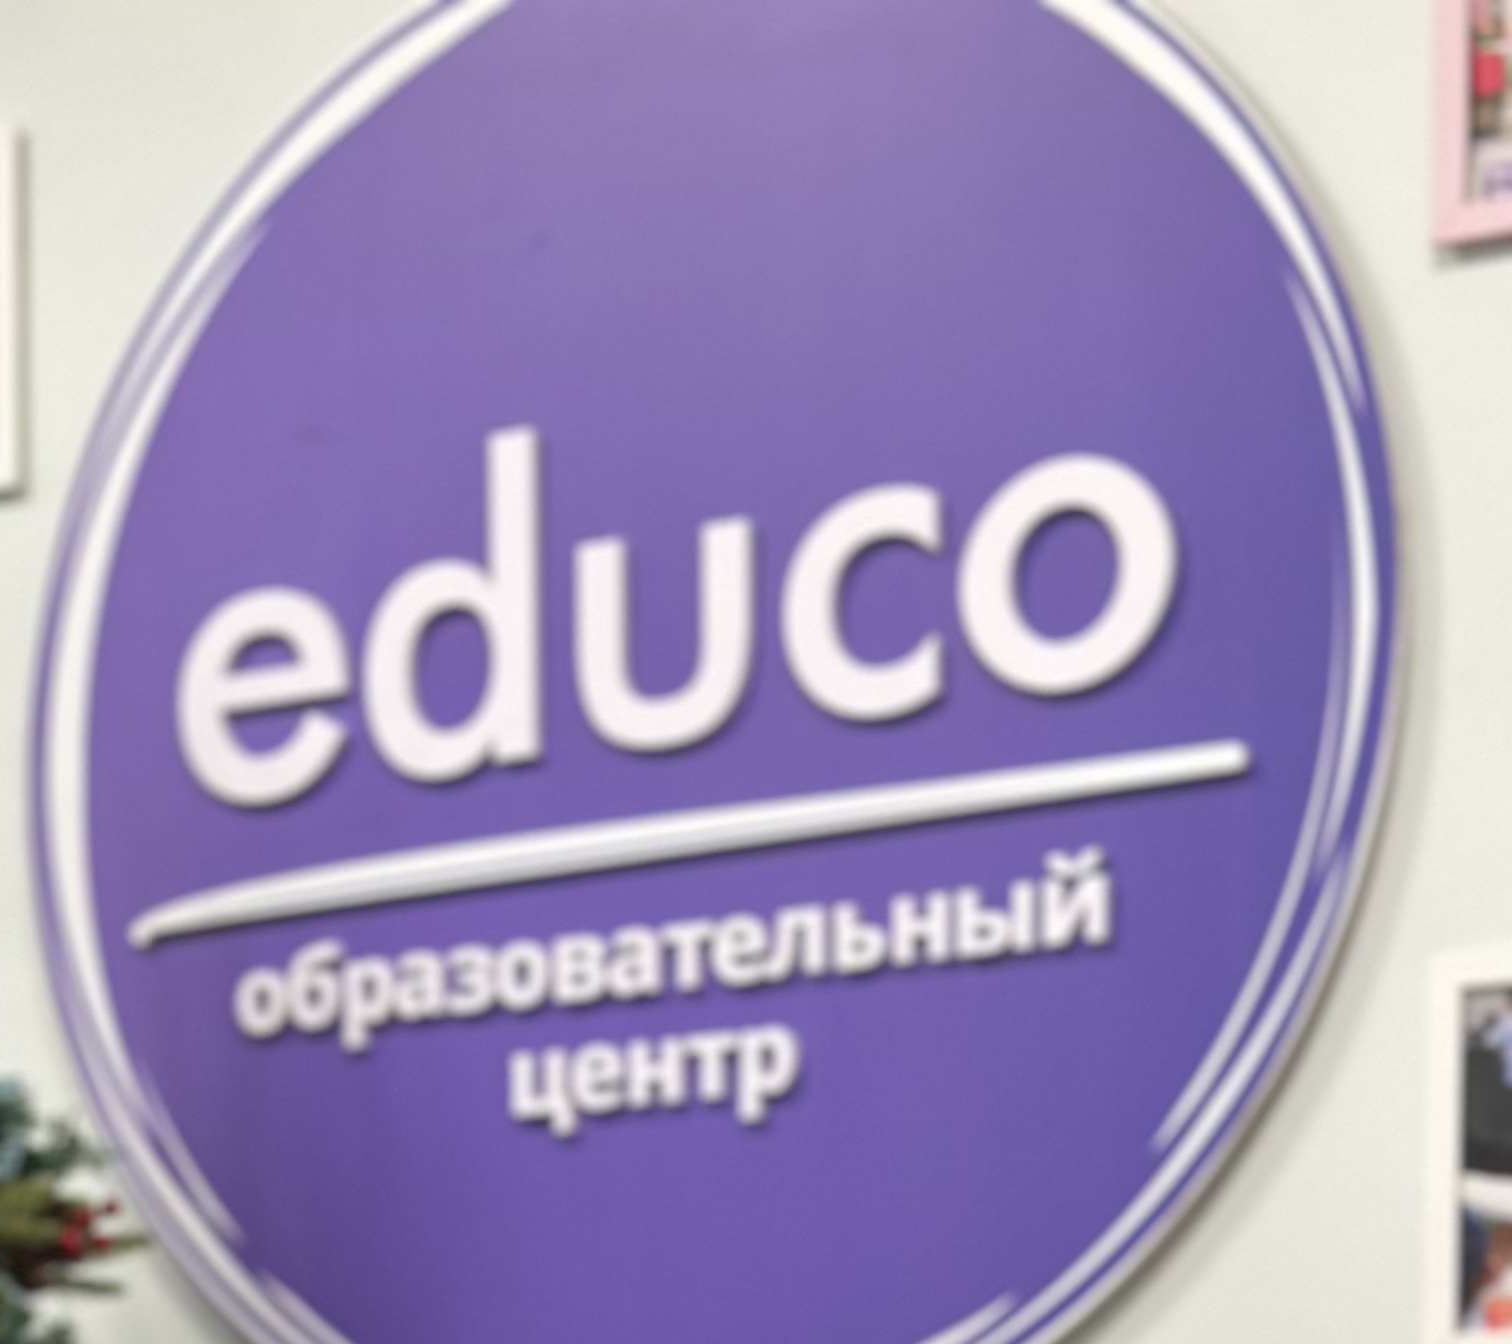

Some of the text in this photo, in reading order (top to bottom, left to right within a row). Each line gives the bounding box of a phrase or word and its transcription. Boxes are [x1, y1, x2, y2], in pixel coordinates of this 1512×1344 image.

[178, 426, 1178, 807] educo
[234, 846, 1110, 1051] образовательный
[510, 1022, 800, 1132] центр
